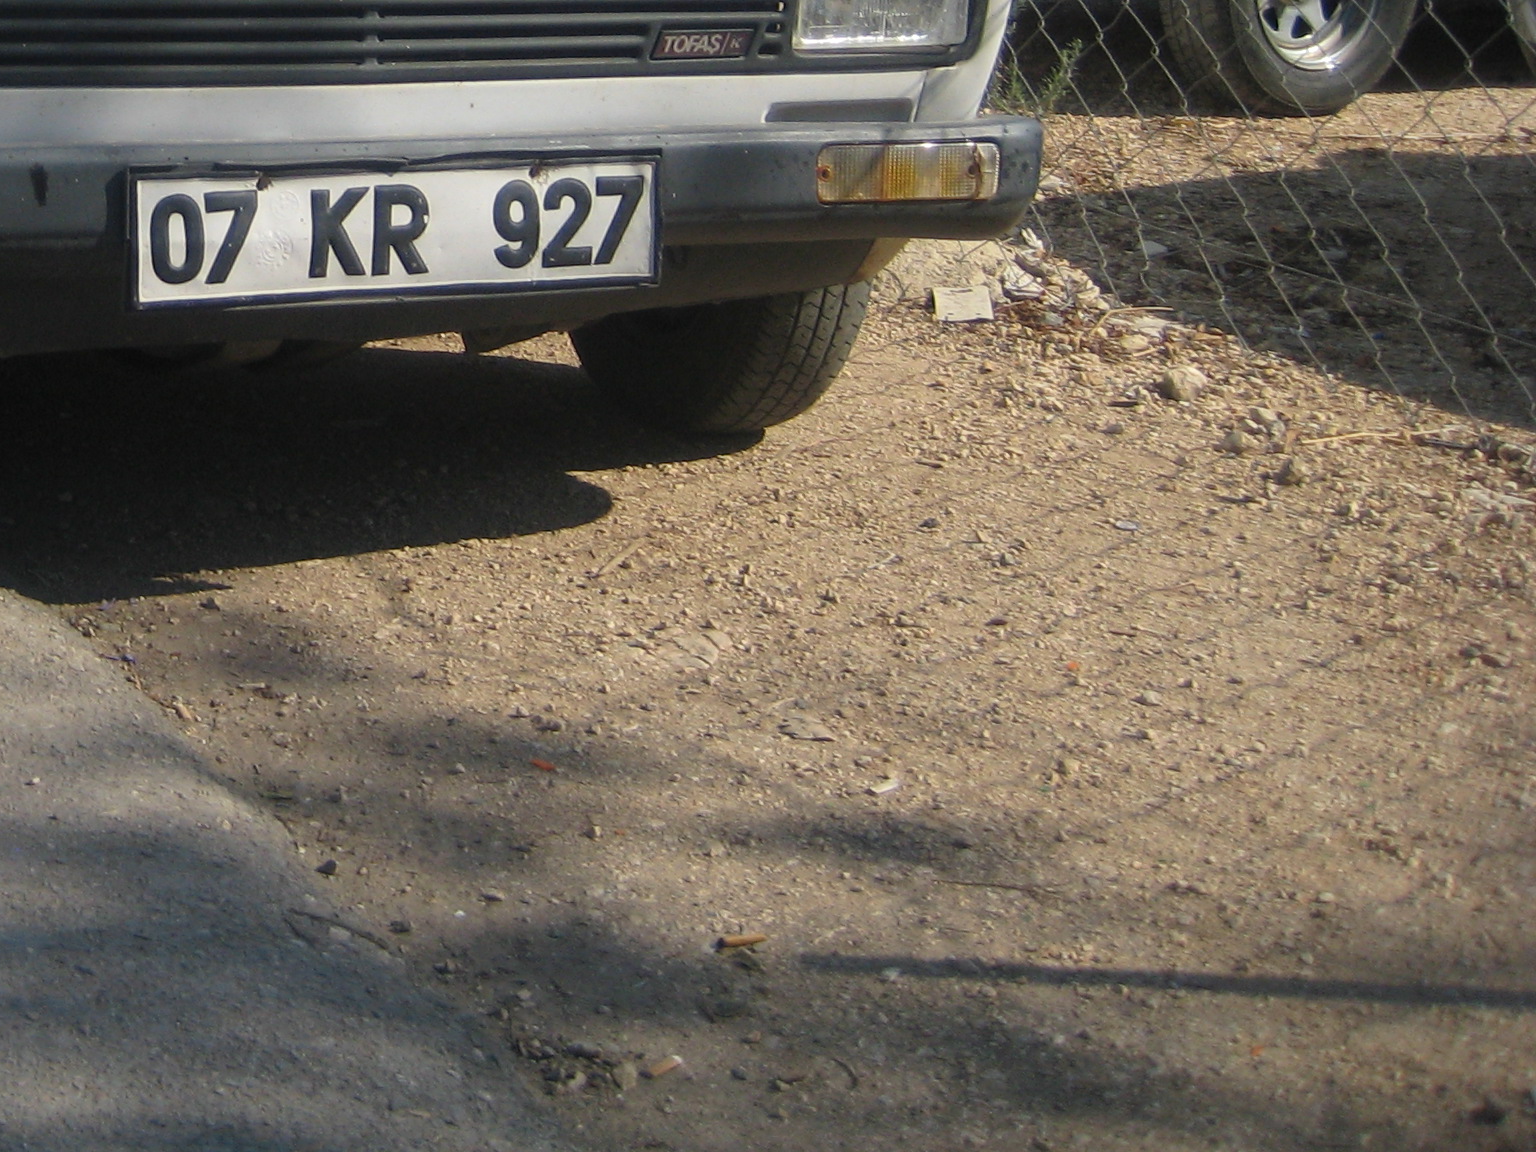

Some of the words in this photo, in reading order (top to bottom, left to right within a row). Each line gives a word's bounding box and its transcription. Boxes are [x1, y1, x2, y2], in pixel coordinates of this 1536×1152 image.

[150, 189, 258, 285] 07
[308, 184, 430, 279] KR
[492, 175, 644, 269] 927
